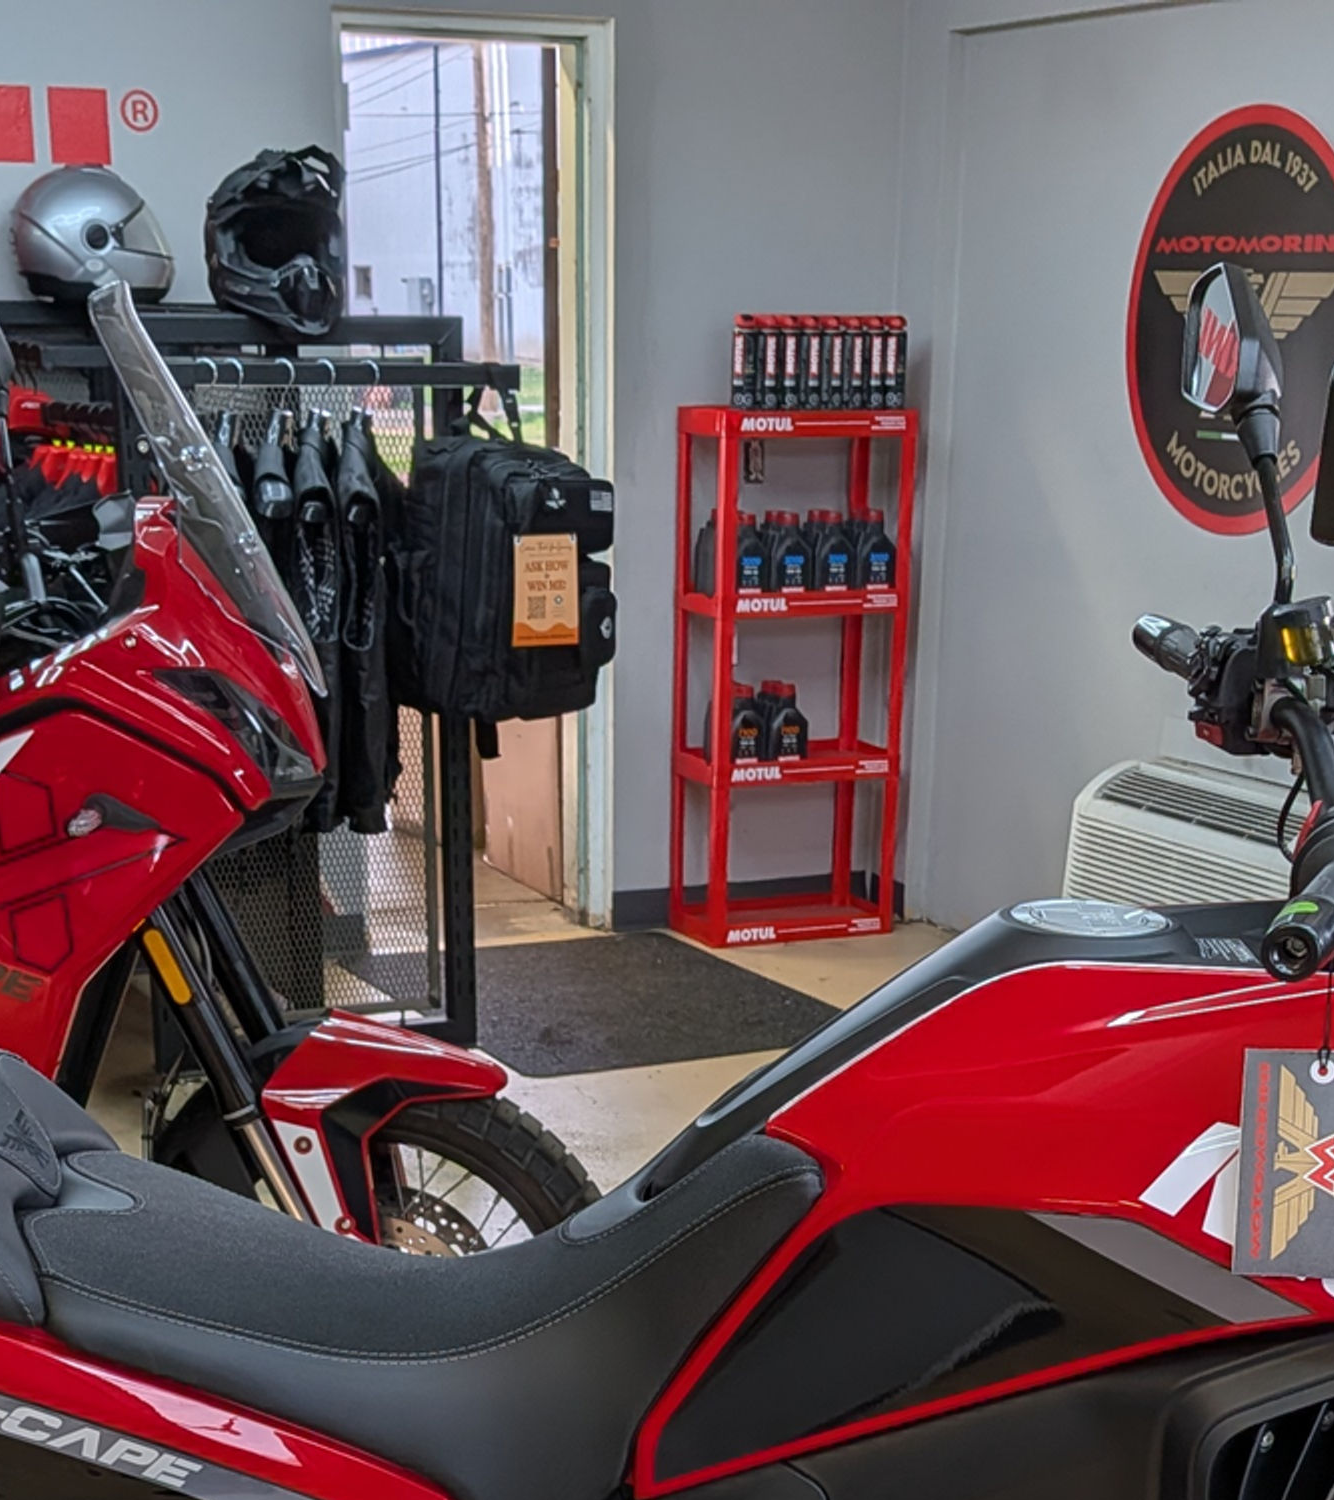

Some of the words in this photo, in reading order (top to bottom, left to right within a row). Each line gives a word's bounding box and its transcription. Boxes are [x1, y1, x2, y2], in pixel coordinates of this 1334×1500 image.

[1192, 143, 1246, 197] ITALIA
[1249, 139, 1283, 169] DAL
[1285, 151, 1320, 194] 1937
[740, 416, 794, 432] MOTUL
[524, 561, 544, 573] ASK
[545, 560, 569, 571] HOW
[527, 580, 547, 591] WIN
[735, 597, 788, 614] MOTUL
[730, 765, 782, 783] MOTUL
[726, 926, 777, 944] MOTUL
